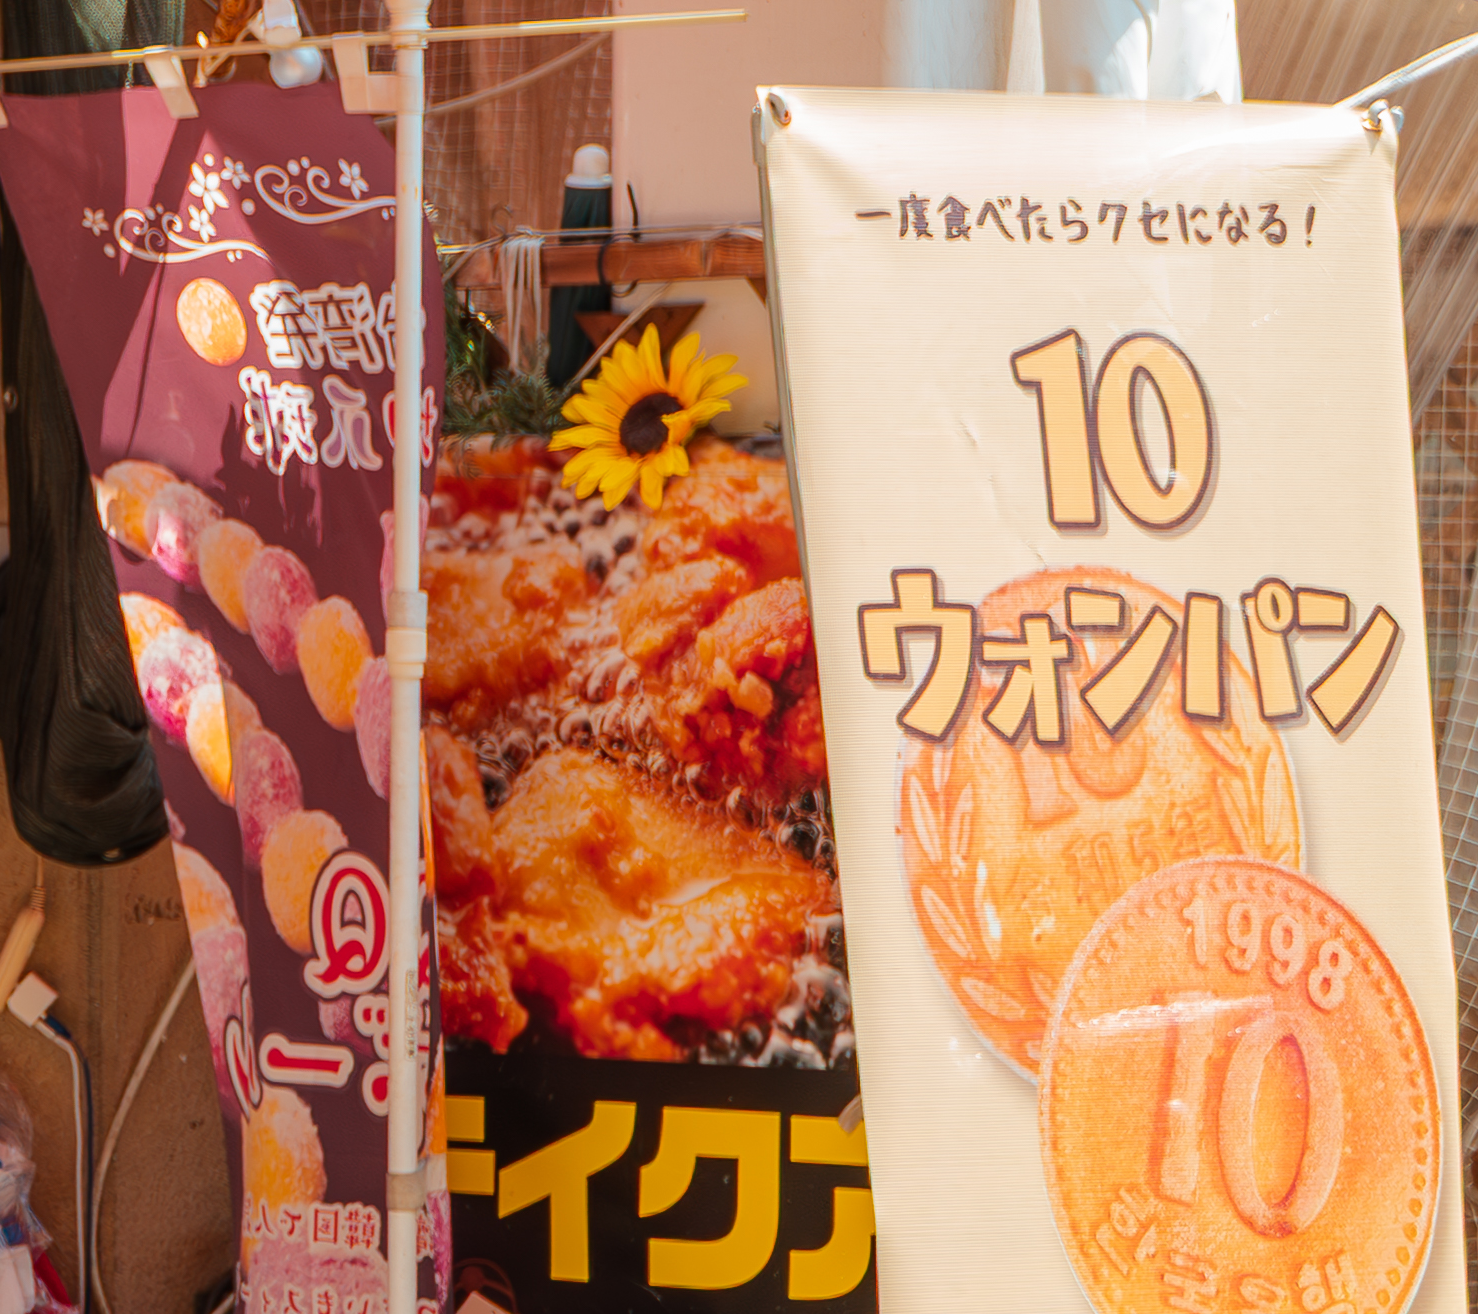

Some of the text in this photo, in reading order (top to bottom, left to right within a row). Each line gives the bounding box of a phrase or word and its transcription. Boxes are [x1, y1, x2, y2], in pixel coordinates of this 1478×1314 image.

[855, 193, 1317, 247] 一度食べたらクセになる！
[1010, 328, 1220, 534] 10
[858, 568, 1403, 748] ウォンパン
[1181, 895, 1353, 1011] 1998
[1150, 989, 1346, 1240] 10
